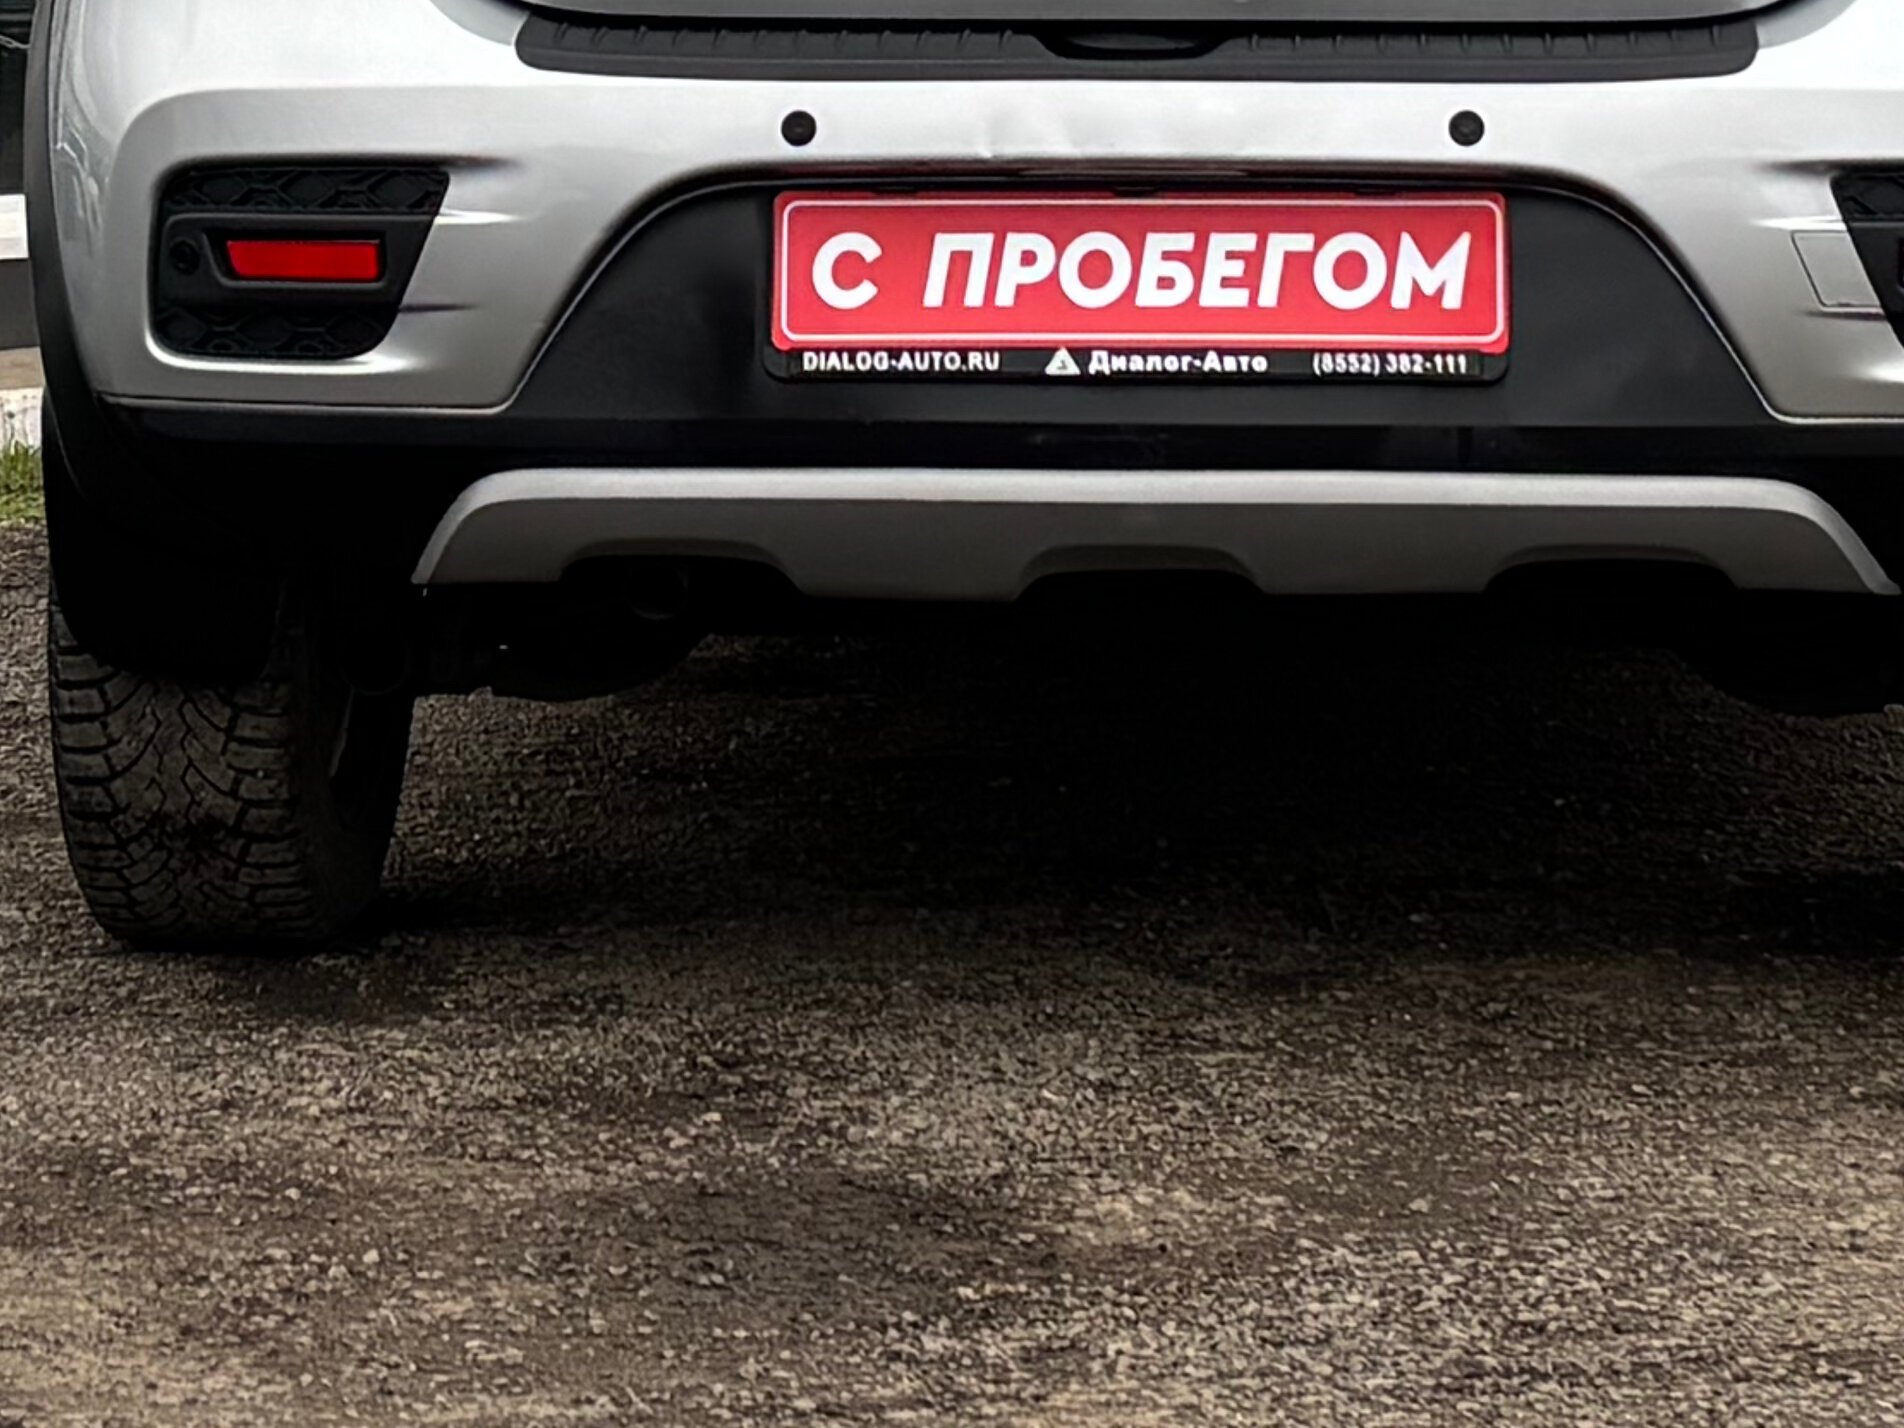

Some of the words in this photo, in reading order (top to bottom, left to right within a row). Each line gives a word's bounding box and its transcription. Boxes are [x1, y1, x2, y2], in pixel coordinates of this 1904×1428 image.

[810, 231, 884, 311] С
[922, 231, 1473, 311] ПРОБЕГОМ
[801, 349, 1001, 373] DIALOG-AUTO.RU
[1087, 348, 1269, 376] Диалог-Авто
[1312, 351, 1381, 377] (8552)
[1385, 352, 1468, 376] 382-111
